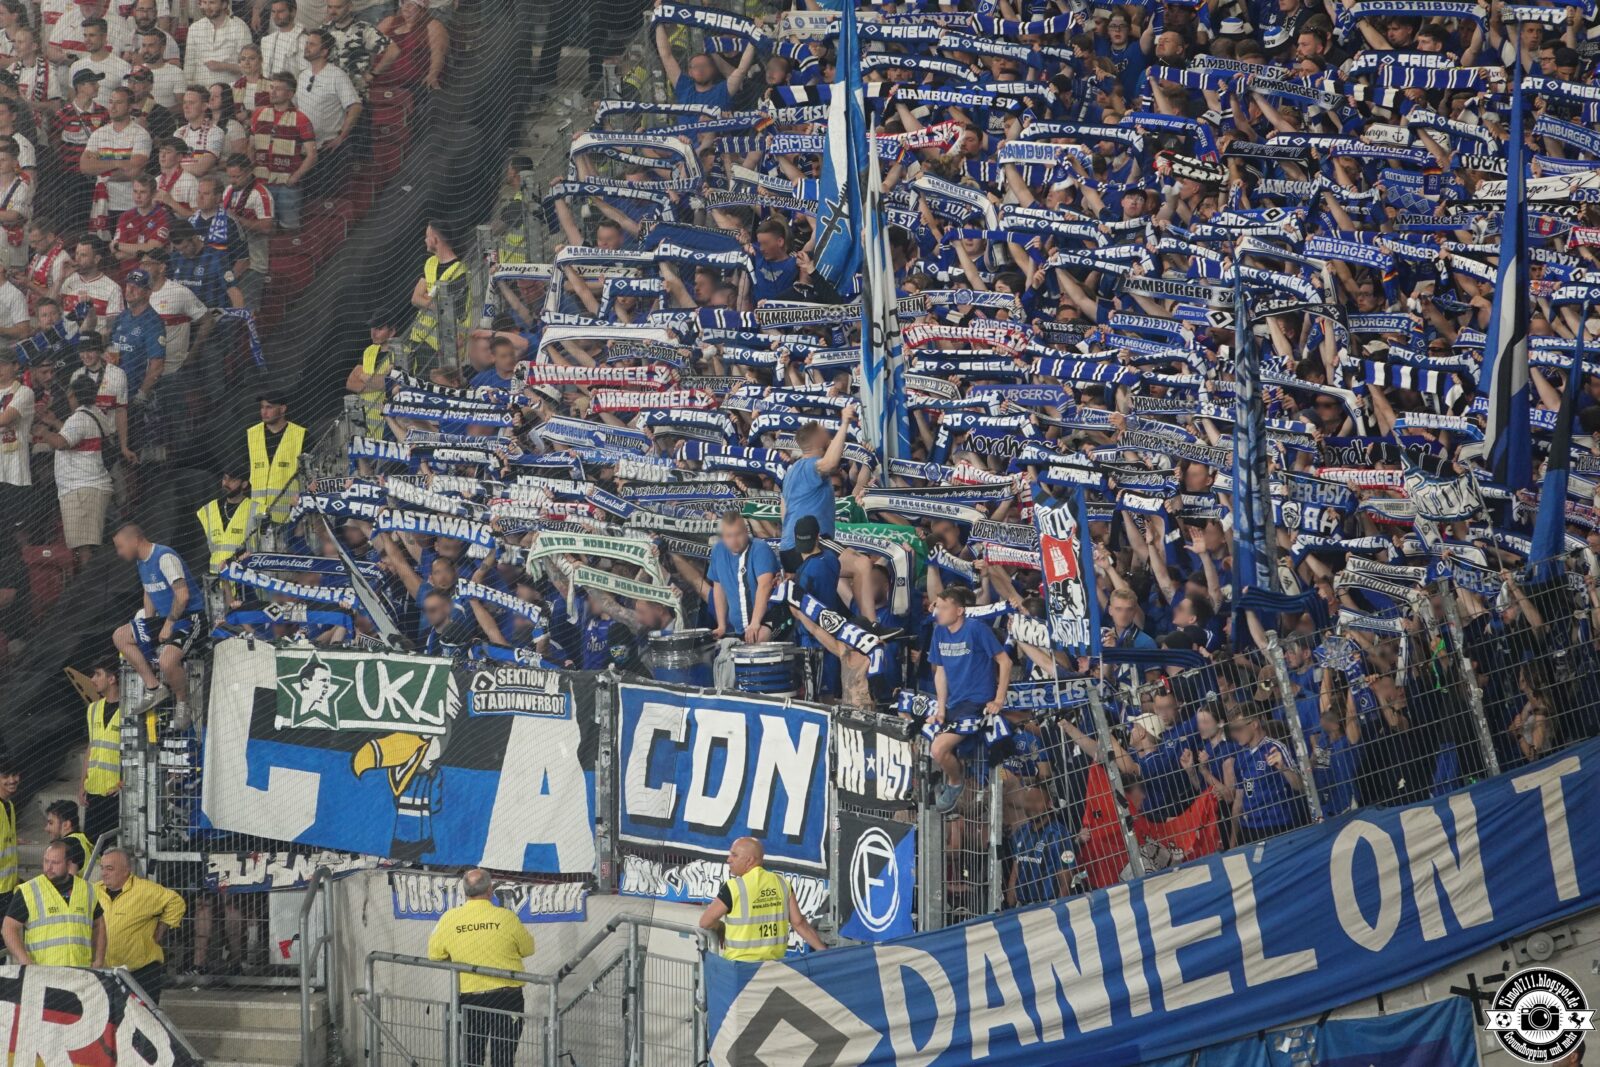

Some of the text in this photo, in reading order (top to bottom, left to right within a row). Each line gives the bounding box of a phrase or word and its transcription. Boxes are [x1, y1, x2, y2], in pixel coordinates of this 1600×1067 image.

[881, 26, 943, 39] TRIBUN
[919, 61, 978, 82] TRIBUN
[1189, 57, 1264, 74] HAMBURGER
[1252, 78, 1321, 99] HAMBURGER
[897, 88, 1017, 110] HAMBURGER SV
[771, 137, 824, 151] HAMBU
[1535, 122, 1591, 147] HAMBURGER
[1125, 278, 1213, 299] HAMBURGER
[757, 310, 822, 325] HAMBURGER
[1112, 313, 1183, 333] ORDTRIBÜNE
[1349, 316, 1398, 328] MBURGER
[907, 325, 1005, 345] HAMBURGER
[533, 365, 648, 382] HAMBURGER
[596, 391, 690, 408] HAMBURGER
[966, 388, 1043, 402] HAURGER
[377, 509, 493, 546] CASTAWAYS
[247, 554, 314, 569] Hansestadt
[229, 562, 356, 605] CASTAWAYS
[456, 577, 542, 624] CASTAWAYS
[497, 669, 546, 688] SEKTION
[356, 661, 446, 725] UKL
[1329, 796, 1496, 953] ON
[395, 874, 466, 913] VORSTA
[760, 888, 777, 898] SDS
[456, 922, 501, 934] SECURITY
[759, 923, 778, 938] 1219
